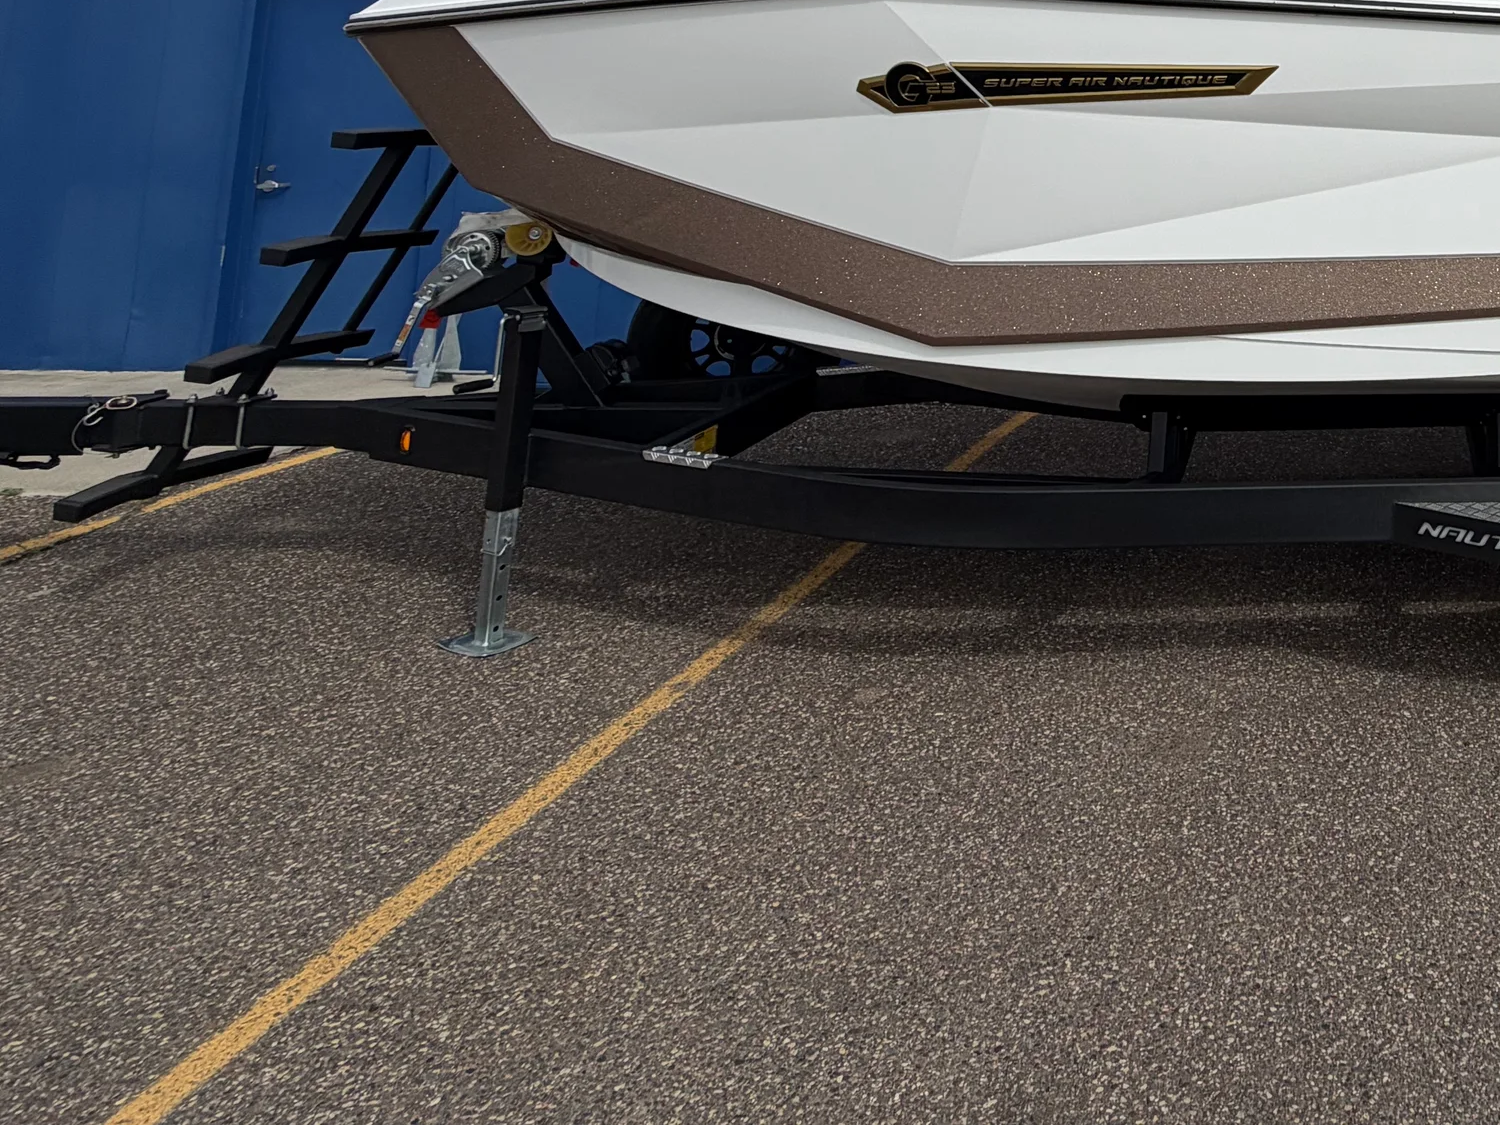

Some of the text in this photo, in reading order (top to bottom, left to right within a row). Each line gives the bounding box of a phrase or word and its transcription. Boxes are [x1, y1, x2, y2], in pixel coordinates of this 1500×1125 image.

[983, 77, 1064, 88] SUPER
[1068, 76, 1108, 87] AIR
[1112, 75, 1229, 86] NAUTIQUE
